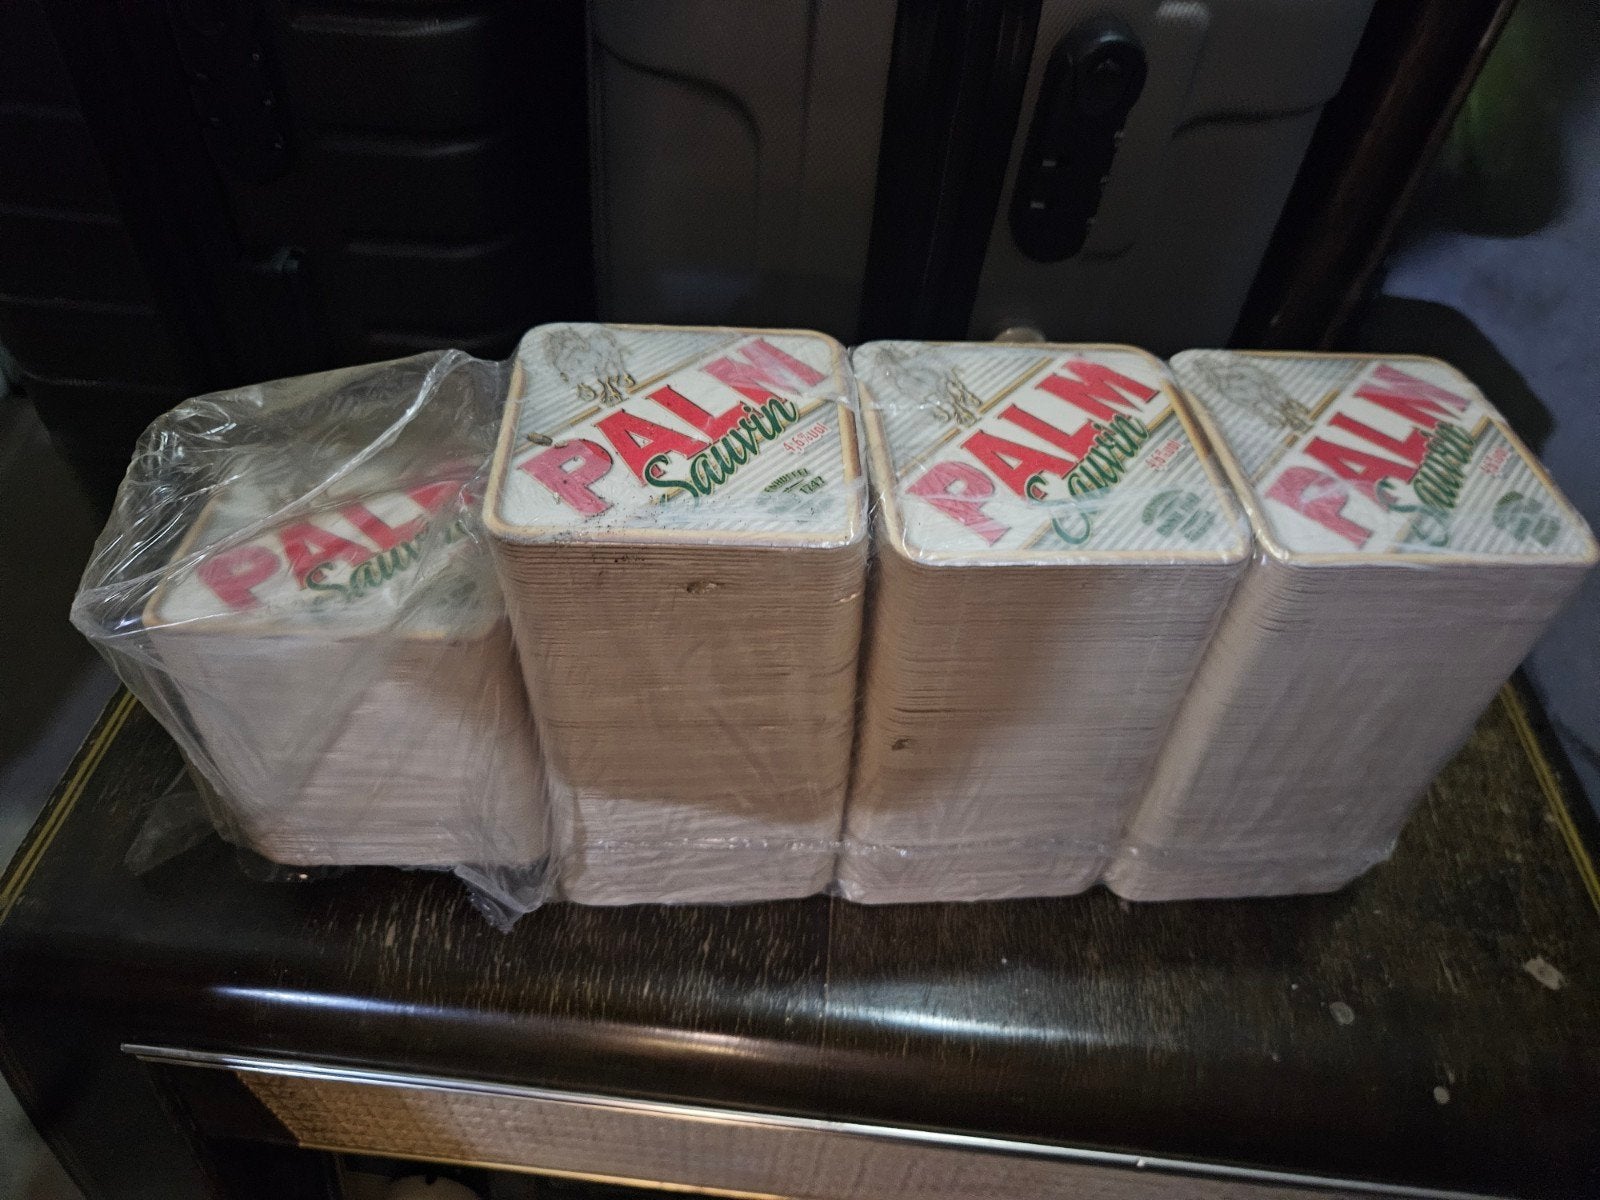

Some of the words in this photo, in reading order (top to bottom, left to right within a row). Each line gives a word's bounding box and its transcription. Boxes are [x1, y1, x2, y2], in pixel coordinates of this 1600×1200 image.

[517, 338, 826, 518] PALM
[644, 397, 797, 502] Sauvin
[905, 357, 1160, 546] PALM
[1025, 413, 1149, 545] Sauvin
[1264, 364, 1471, 549] PALM
